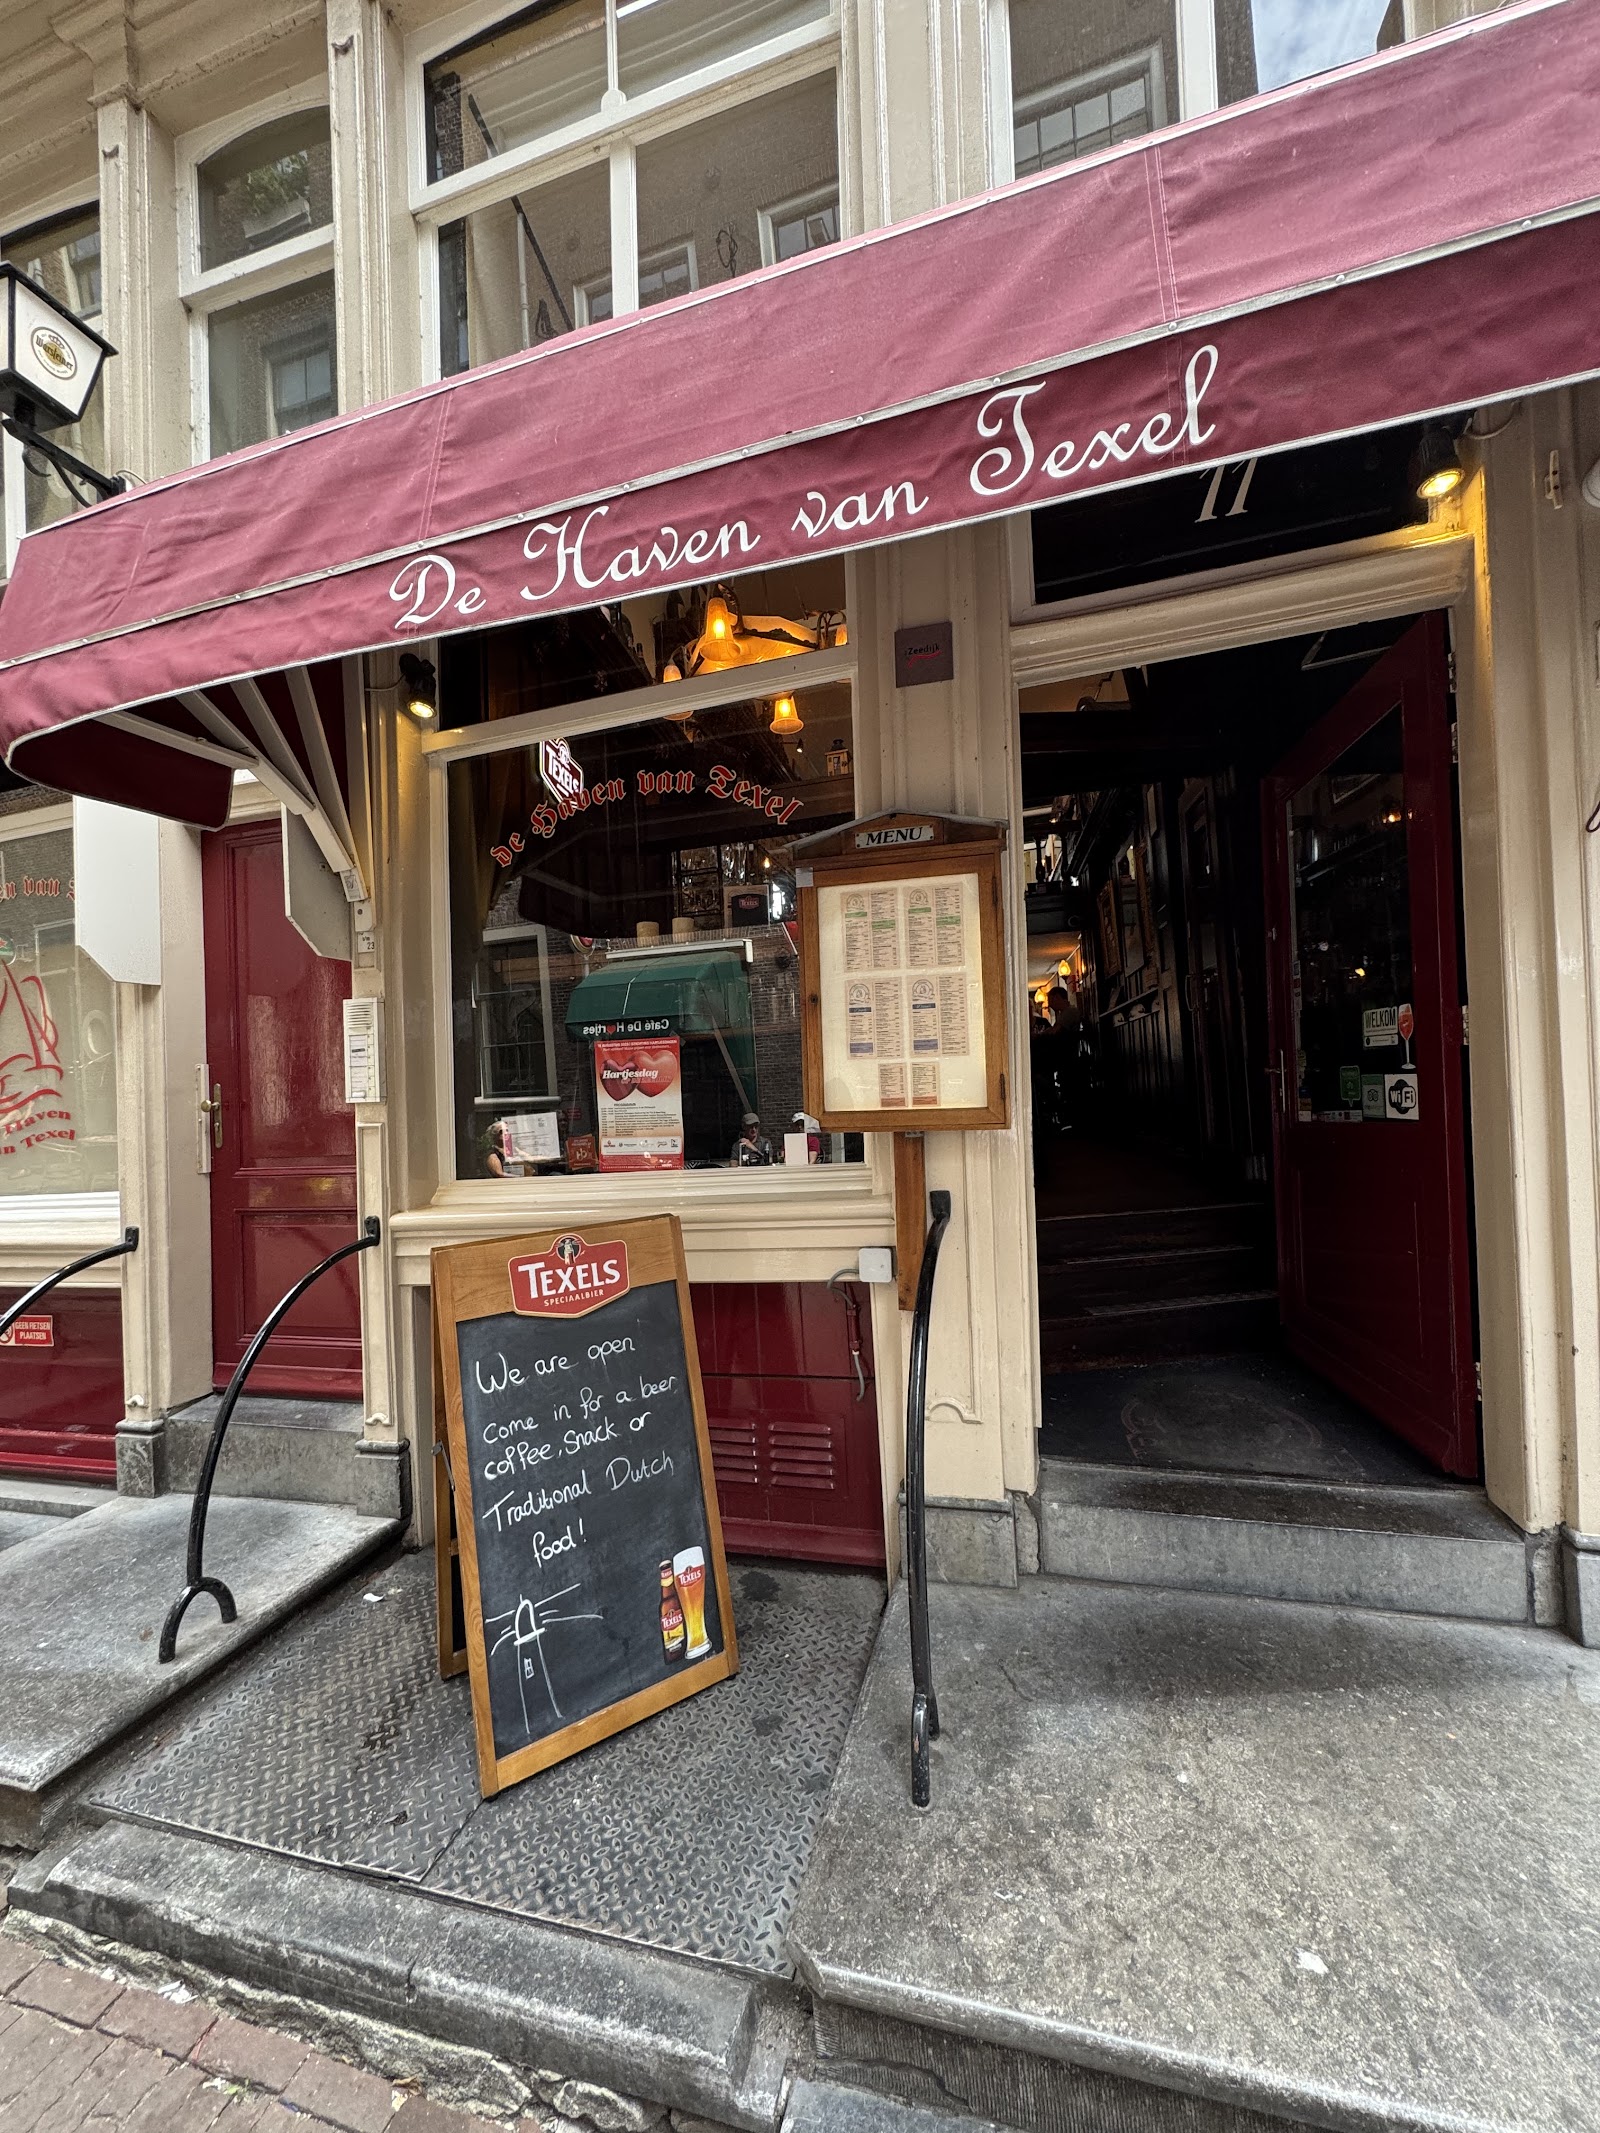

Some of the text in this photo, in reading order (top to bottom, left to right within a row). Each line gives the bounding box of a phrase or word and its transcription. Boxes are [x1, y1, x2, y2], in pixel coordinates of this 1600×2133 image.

[389, 345, 1218, 630] De Haven van Texel
[908, 643, 940, 656] Zeedijk
[545, 744, 580, 792] TEXELS
[490, 765, 805, 868] de Haven van Texel
[866, 827, 923, 845] MENU
[22, 876, 60, 897] van
[1365, 1007, 1396, 1029] WELKOM
[603, 1069, 658, 1080] Hartjesdag
[20, 1129, 75, 1148] Texel
[518, 1260, 620, 1299] TEXELS
[543, 1289, 604, 1307] SPECIAALBIER
[15, 1322, 29, 1330] GEEN
[20, 1332, 47, 1340] PLAATSEN
[476, 1337, 636, 1394] We are open
[553, 1404, 572, 1421] in
[579, 1386, 604, 1420] for
[615, 1390, 633, 1404] a
[629, 1411, 652, 1431] or
[482, 1450, 675, 1532] Traditional Dutch
[678, 1569, 702, 1585] TEXELS
[661, 1613, 683, 1629] TEXELS
